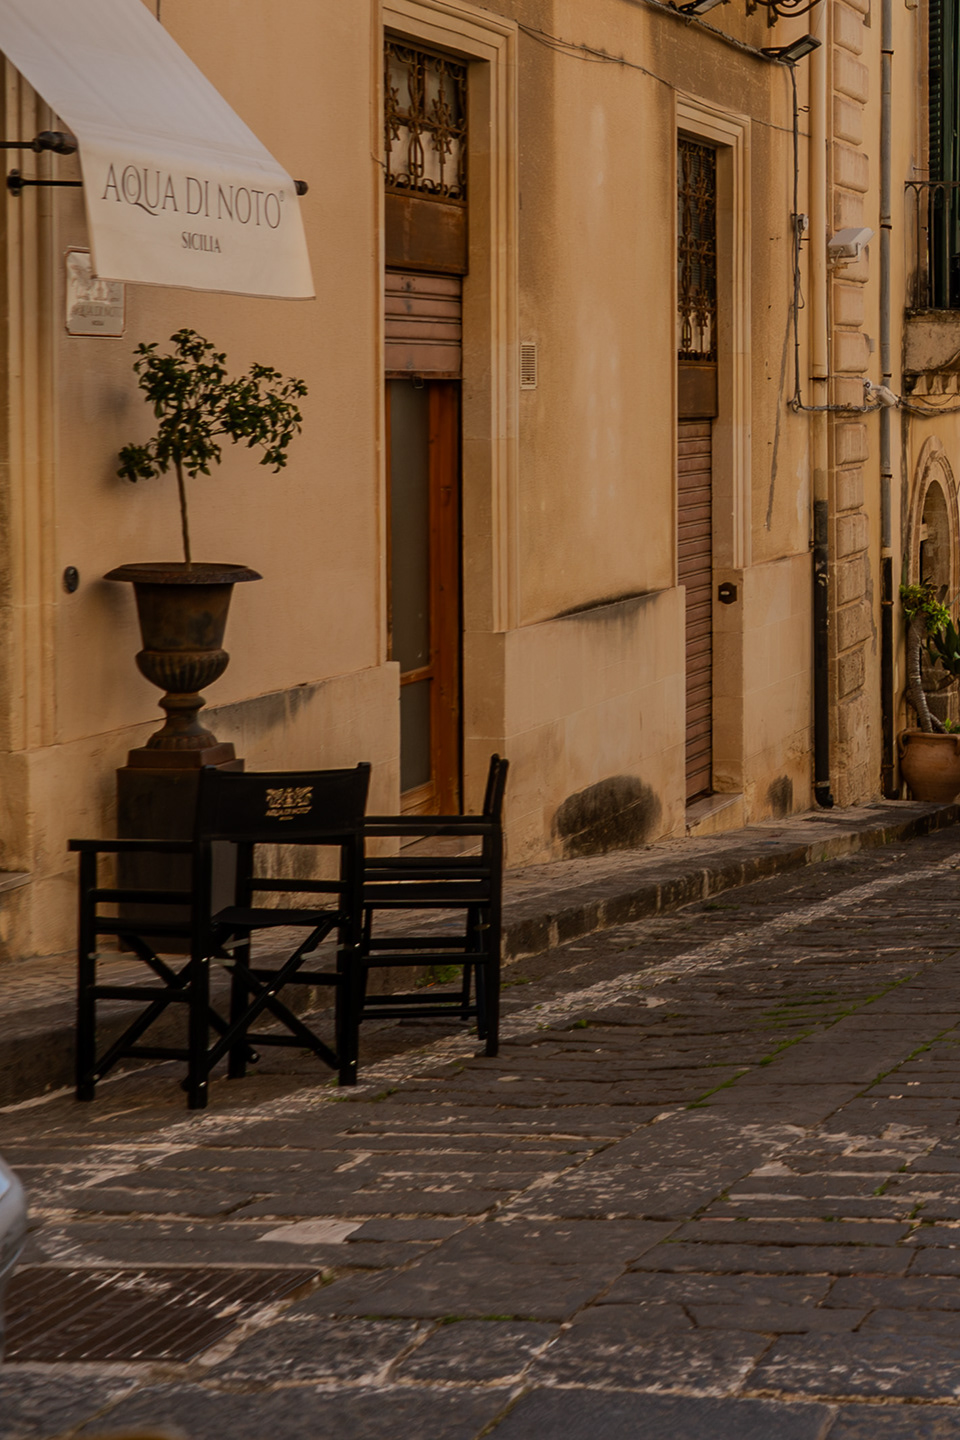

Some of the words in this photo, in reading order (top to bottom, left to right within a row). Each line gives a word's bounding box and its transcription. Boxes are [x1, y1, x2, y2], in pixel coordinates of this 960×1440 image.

[101, 163, 179, 216] AQUA
[186, 176, 209, 217] DI
[182, 231, 222, 253] SICILIA
